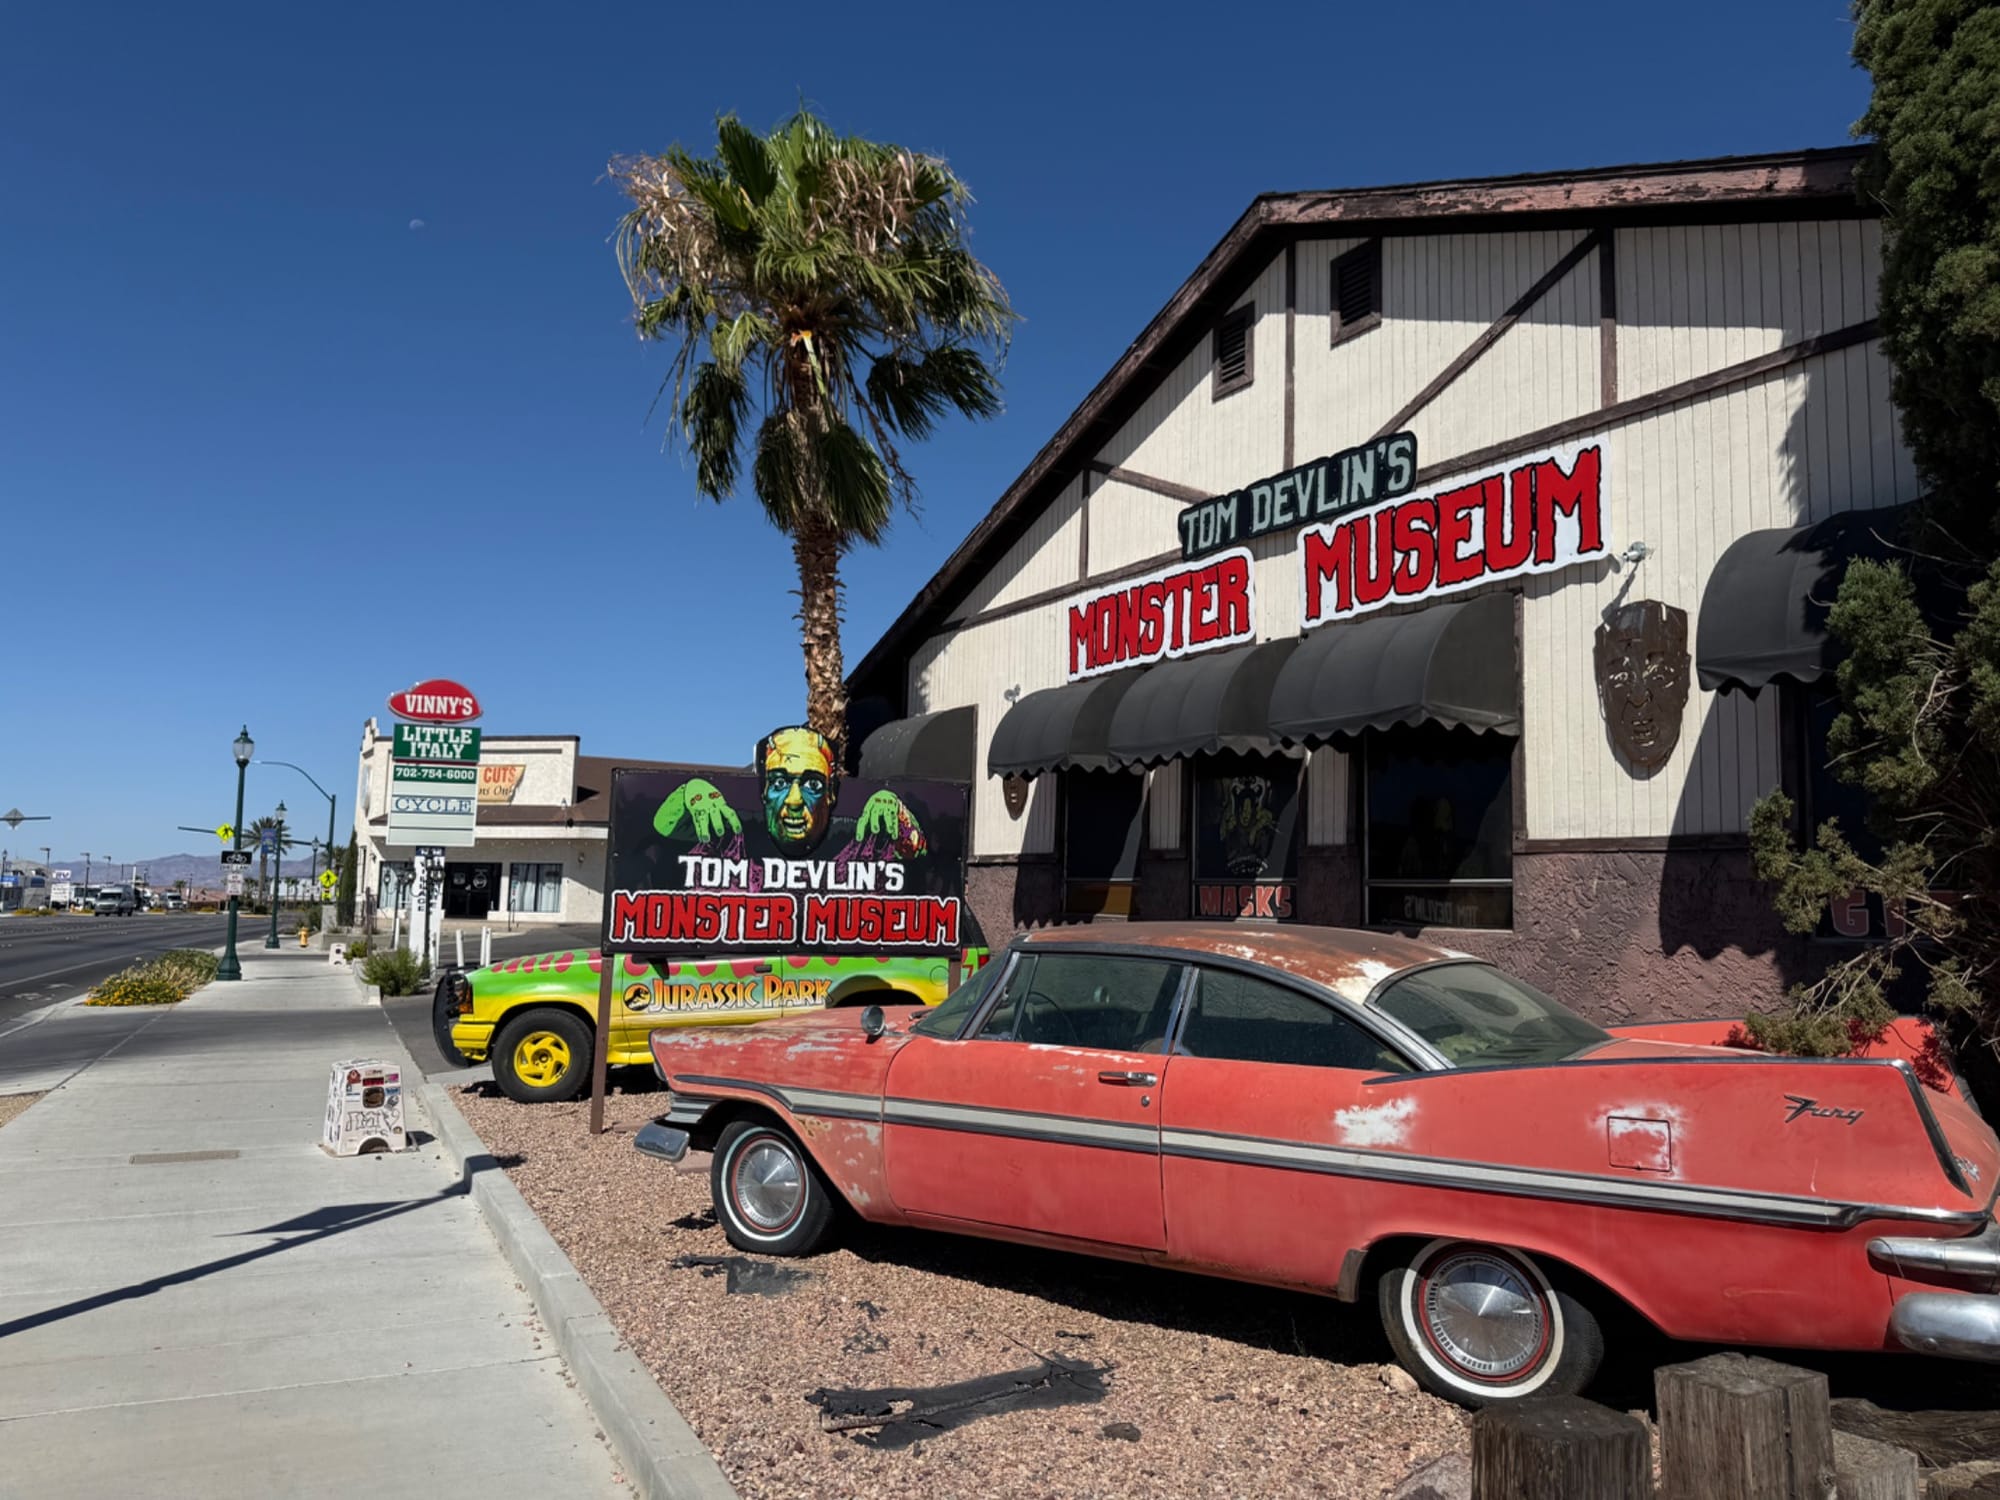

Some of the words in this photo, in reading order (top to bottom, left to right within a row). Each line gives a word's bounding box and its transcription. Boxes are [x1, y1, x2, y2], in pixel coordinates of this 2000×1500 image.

[1182, 496, 1239, 555] TOM
[1250, 438, 1413, 535] DEVLIN'S
[1068, 555, 1251, 676] MONSTER
[1303, 443, 1604, 621] MUSEUM
[404, 693, 474, 716] VINNY'S
[402, 726, 472, 745] LITTLE
[410, 743, 465, 759] ITALY
[395, 767, 475, 780] 702-754-6000
[483, 766, 516, 784] CUTS
[395, 798, 472, 813] CYCLE
[677, 855, 749, 889] TOM
[762, 857, 905, 891] DEVLIN'S
[613, 892, 794, 941] MONSTER
[805, 896, 958, 943] MUSEUM
[1199, 885, 1293, 918] MASKS
[649, 977, 758, 1013] JURASSIC
[761, 974, 833, 1008] PARK
[1783, 1094, 1865, 1126] Fury
